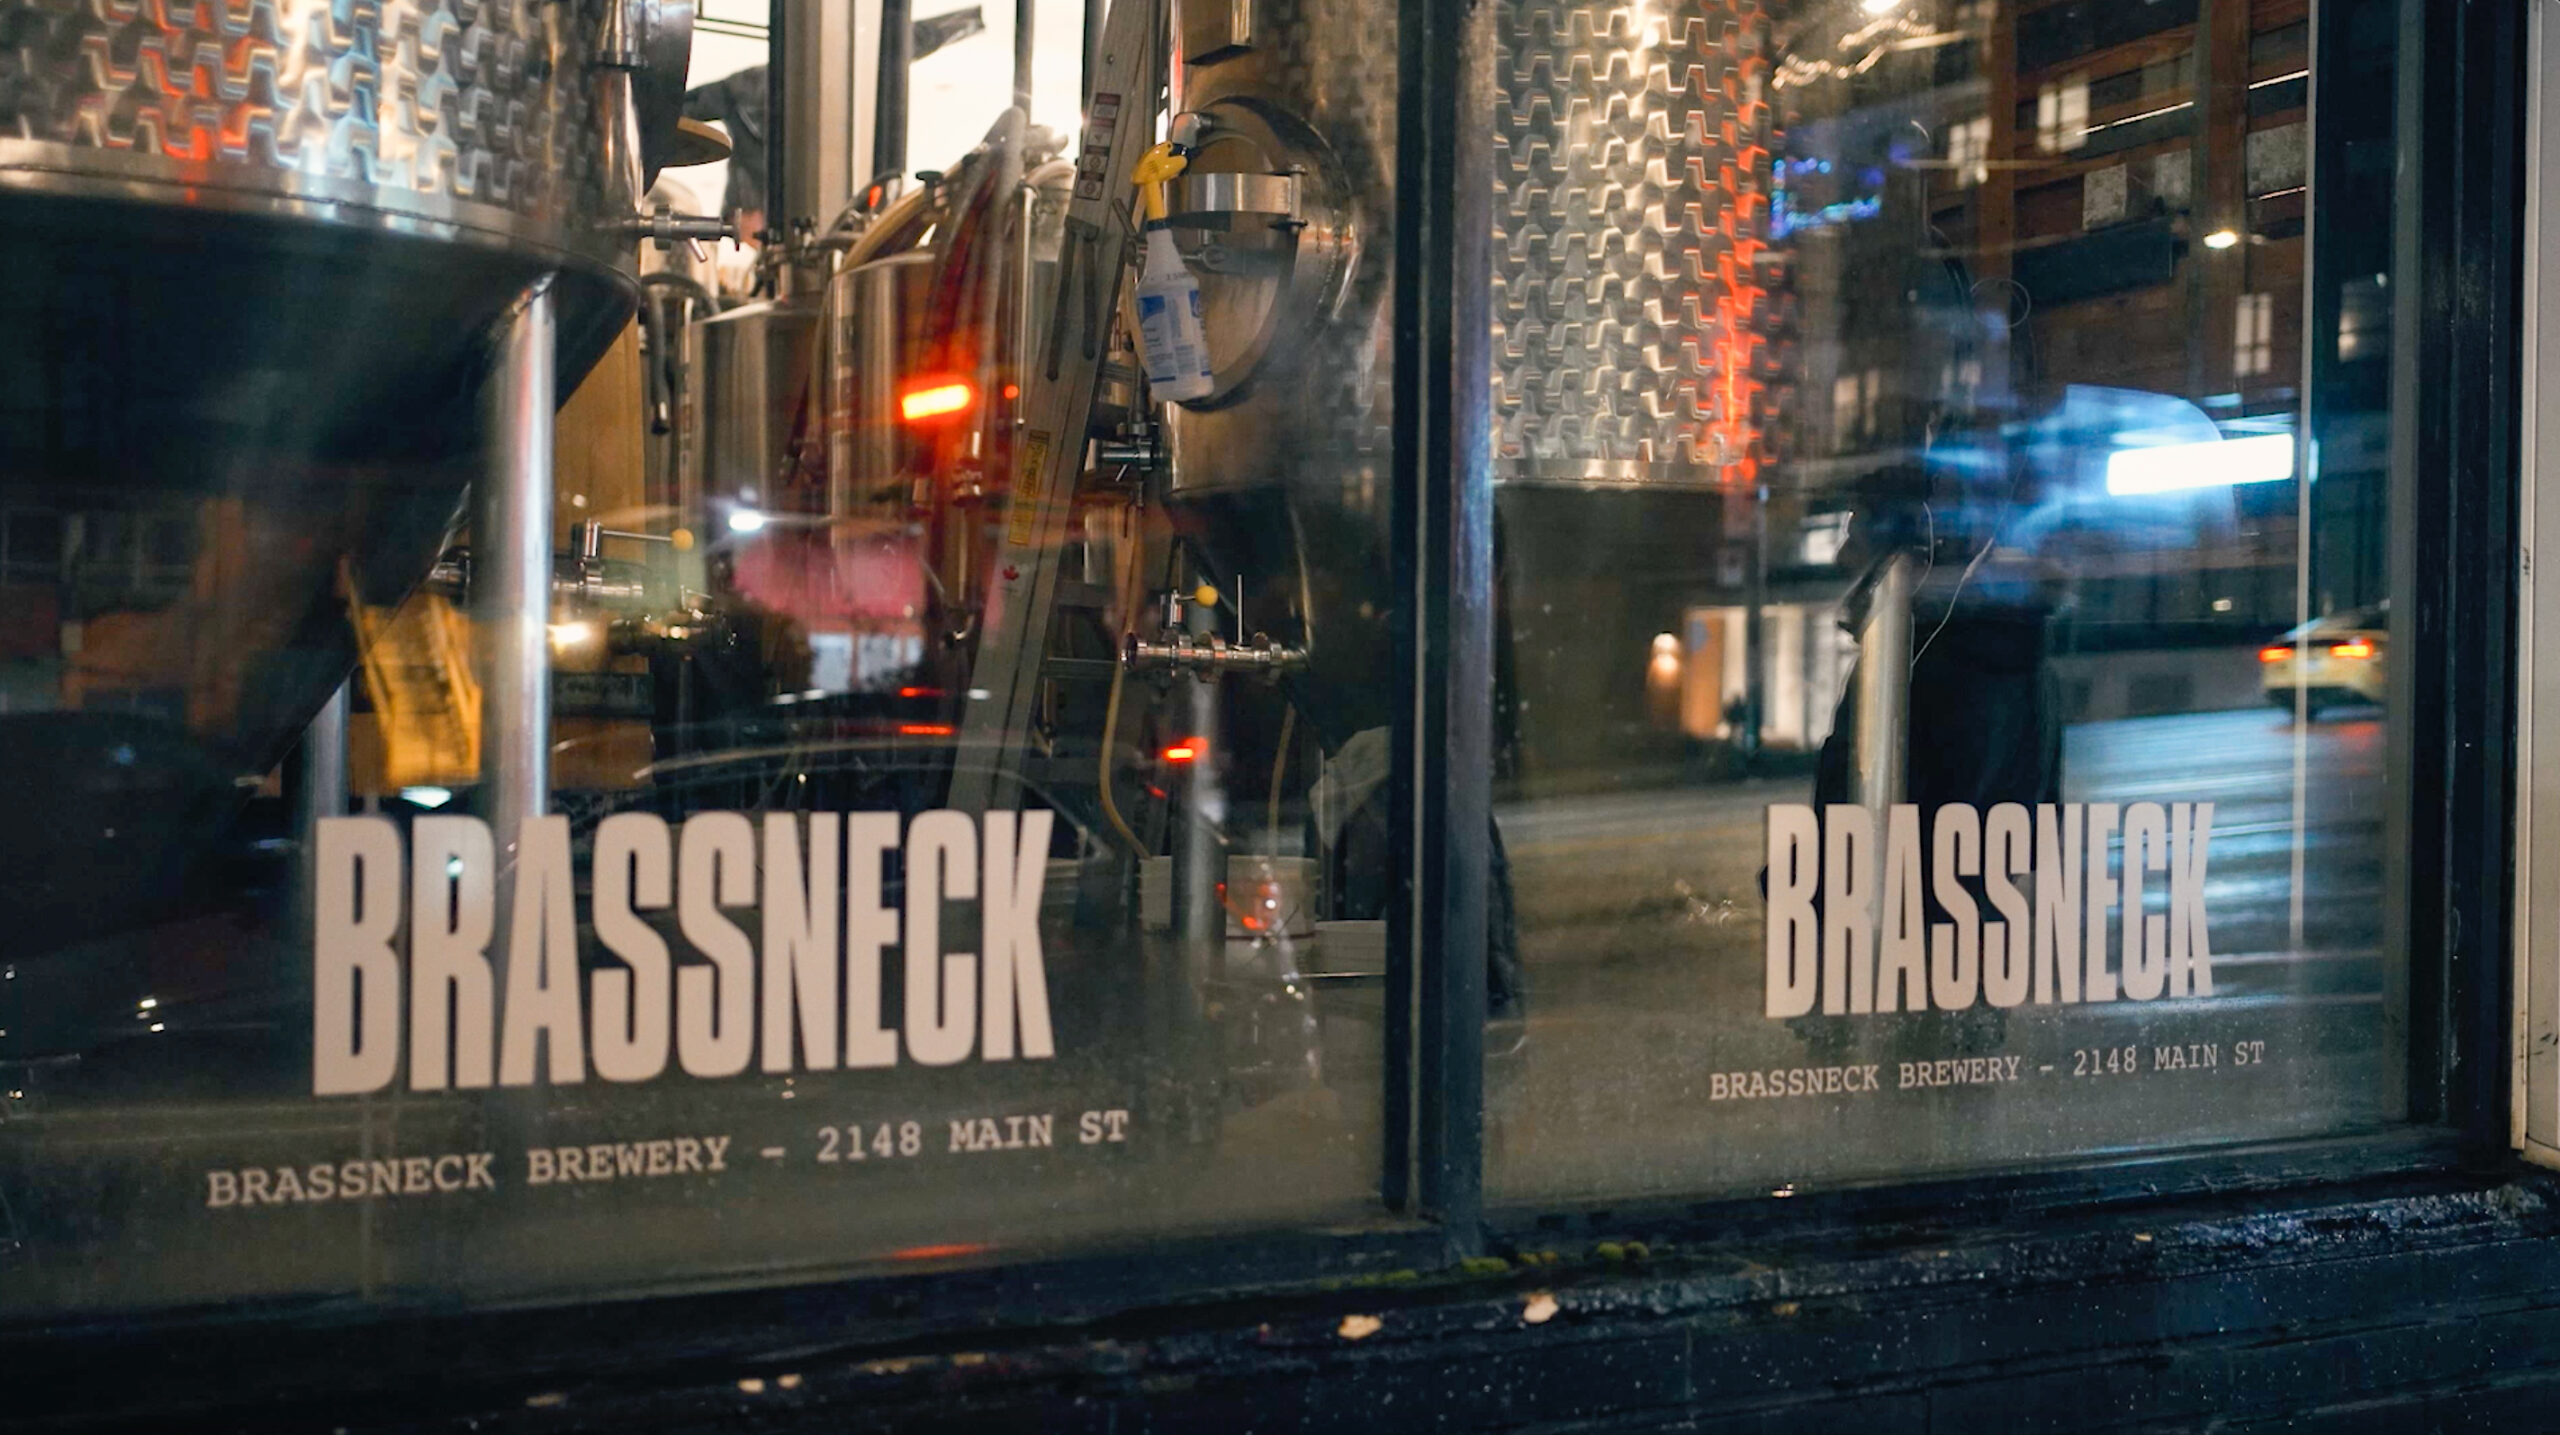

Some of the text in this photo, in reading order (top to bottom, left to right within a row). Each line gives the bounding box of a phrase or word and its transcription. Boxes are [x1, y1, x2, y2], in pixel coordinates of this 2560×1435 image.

[312, 808, 1055, 1096] BRASSNECK
[1765, 801, 2215, 1019] BRASSNECK
[1709, 1064, 1880, 1101] BRASSNECK
[1898, 1055, 2021, 1089] BREWERY
[2073, 1047, 2137, 1076] 2148
[2153, 1043, 2218, 1071] MAIN
[2234, 1040, 2265, 1066] ST
[206, 1152, 496, 1208] BRASSNECK
[526, 1135, 731, 1185] BREWERY
[816, 1120, 922, 1163] 2148
[948, 1113, 1054, 1153] MAIN
[1078, 1109, 1129, 1144] ST
